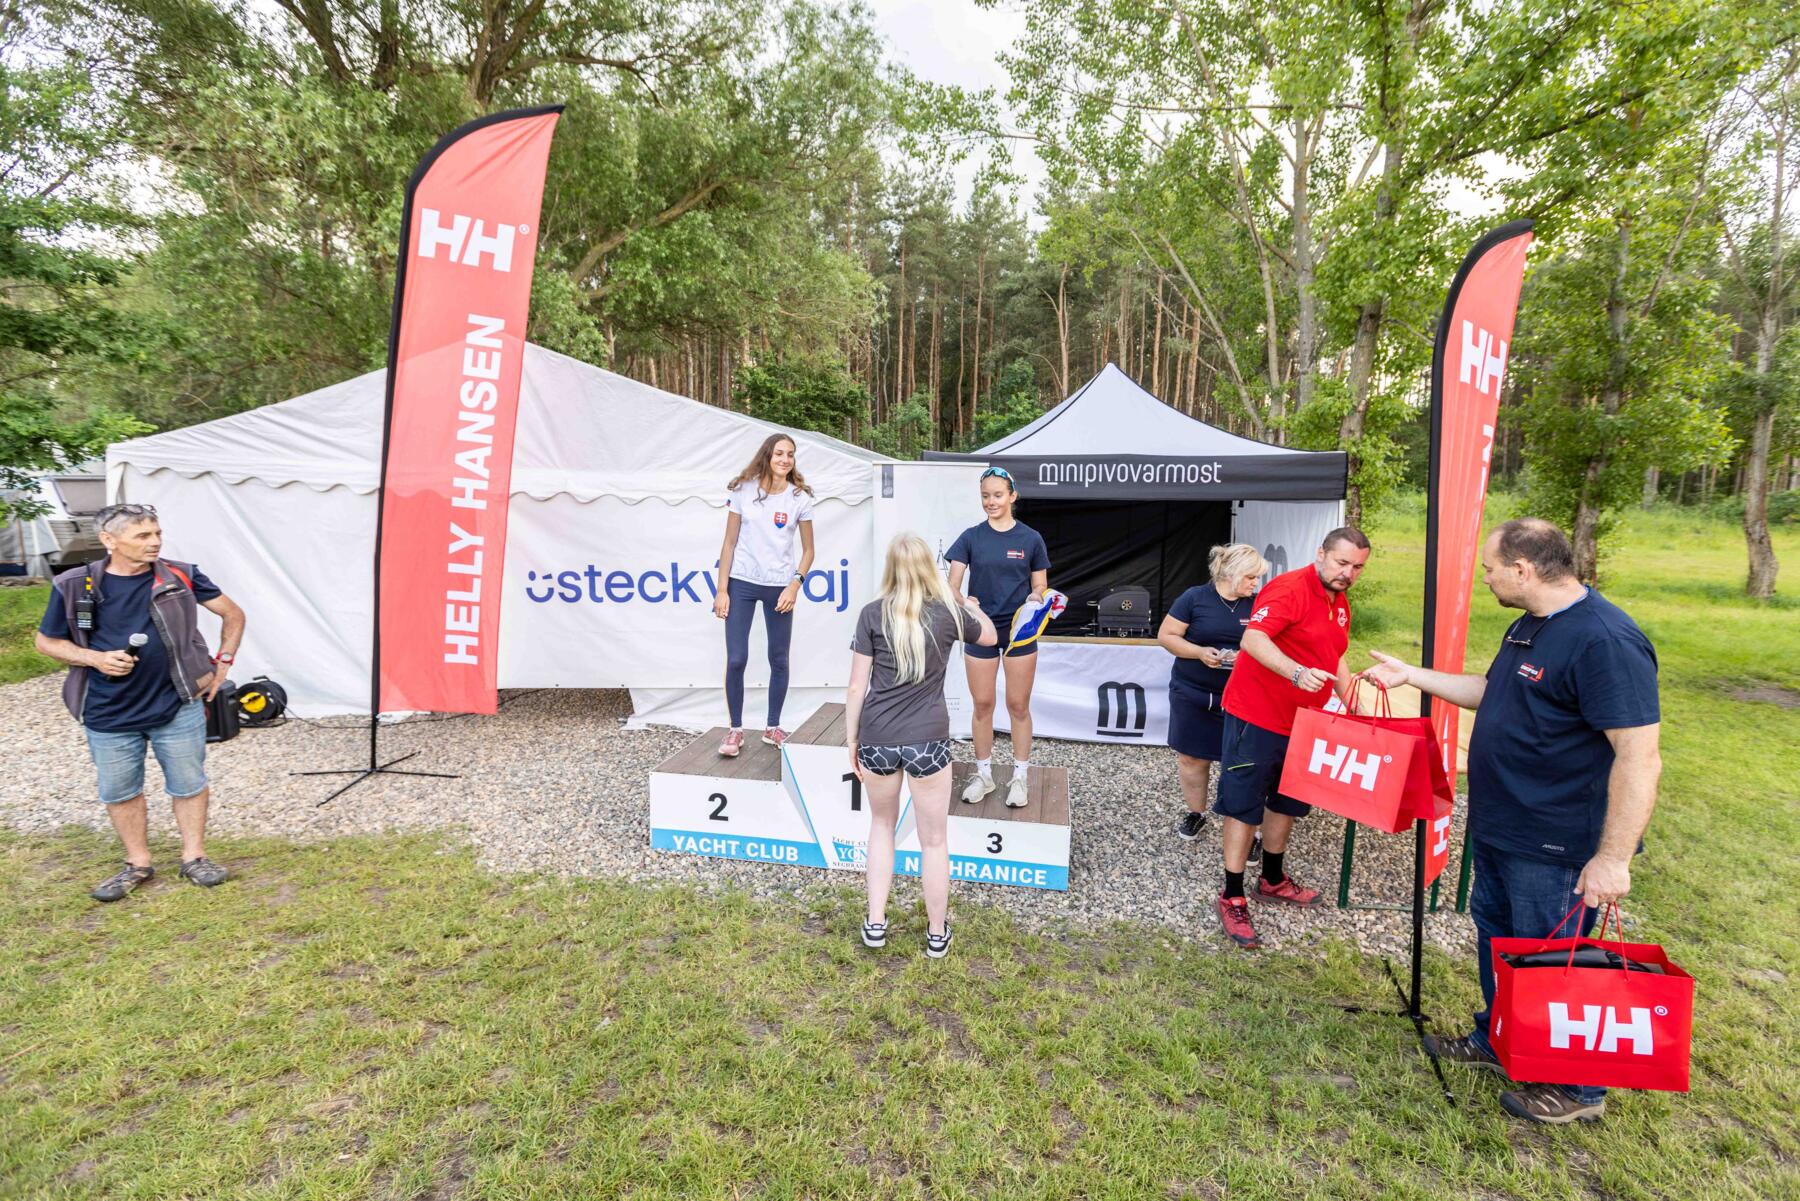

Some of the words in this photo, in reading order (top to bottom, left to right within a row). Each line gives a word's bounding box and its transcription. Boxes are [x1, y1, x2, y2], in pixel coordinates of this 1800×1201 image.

[451, 313, 505, 509] HANSEN
[1039, 462, 1222, 487] minipivovarmost
[444, 522, 484, 665] HELLY
[842, 772, 862, 811] 1
[708, 792, 729, 822] 2
[673, 835, 739, 856] YACHT
[746, 842, 798, 862] CLUB
[986, 832, 1003, 854] 3
[905, 856, 1047, 886] NHRANICE
